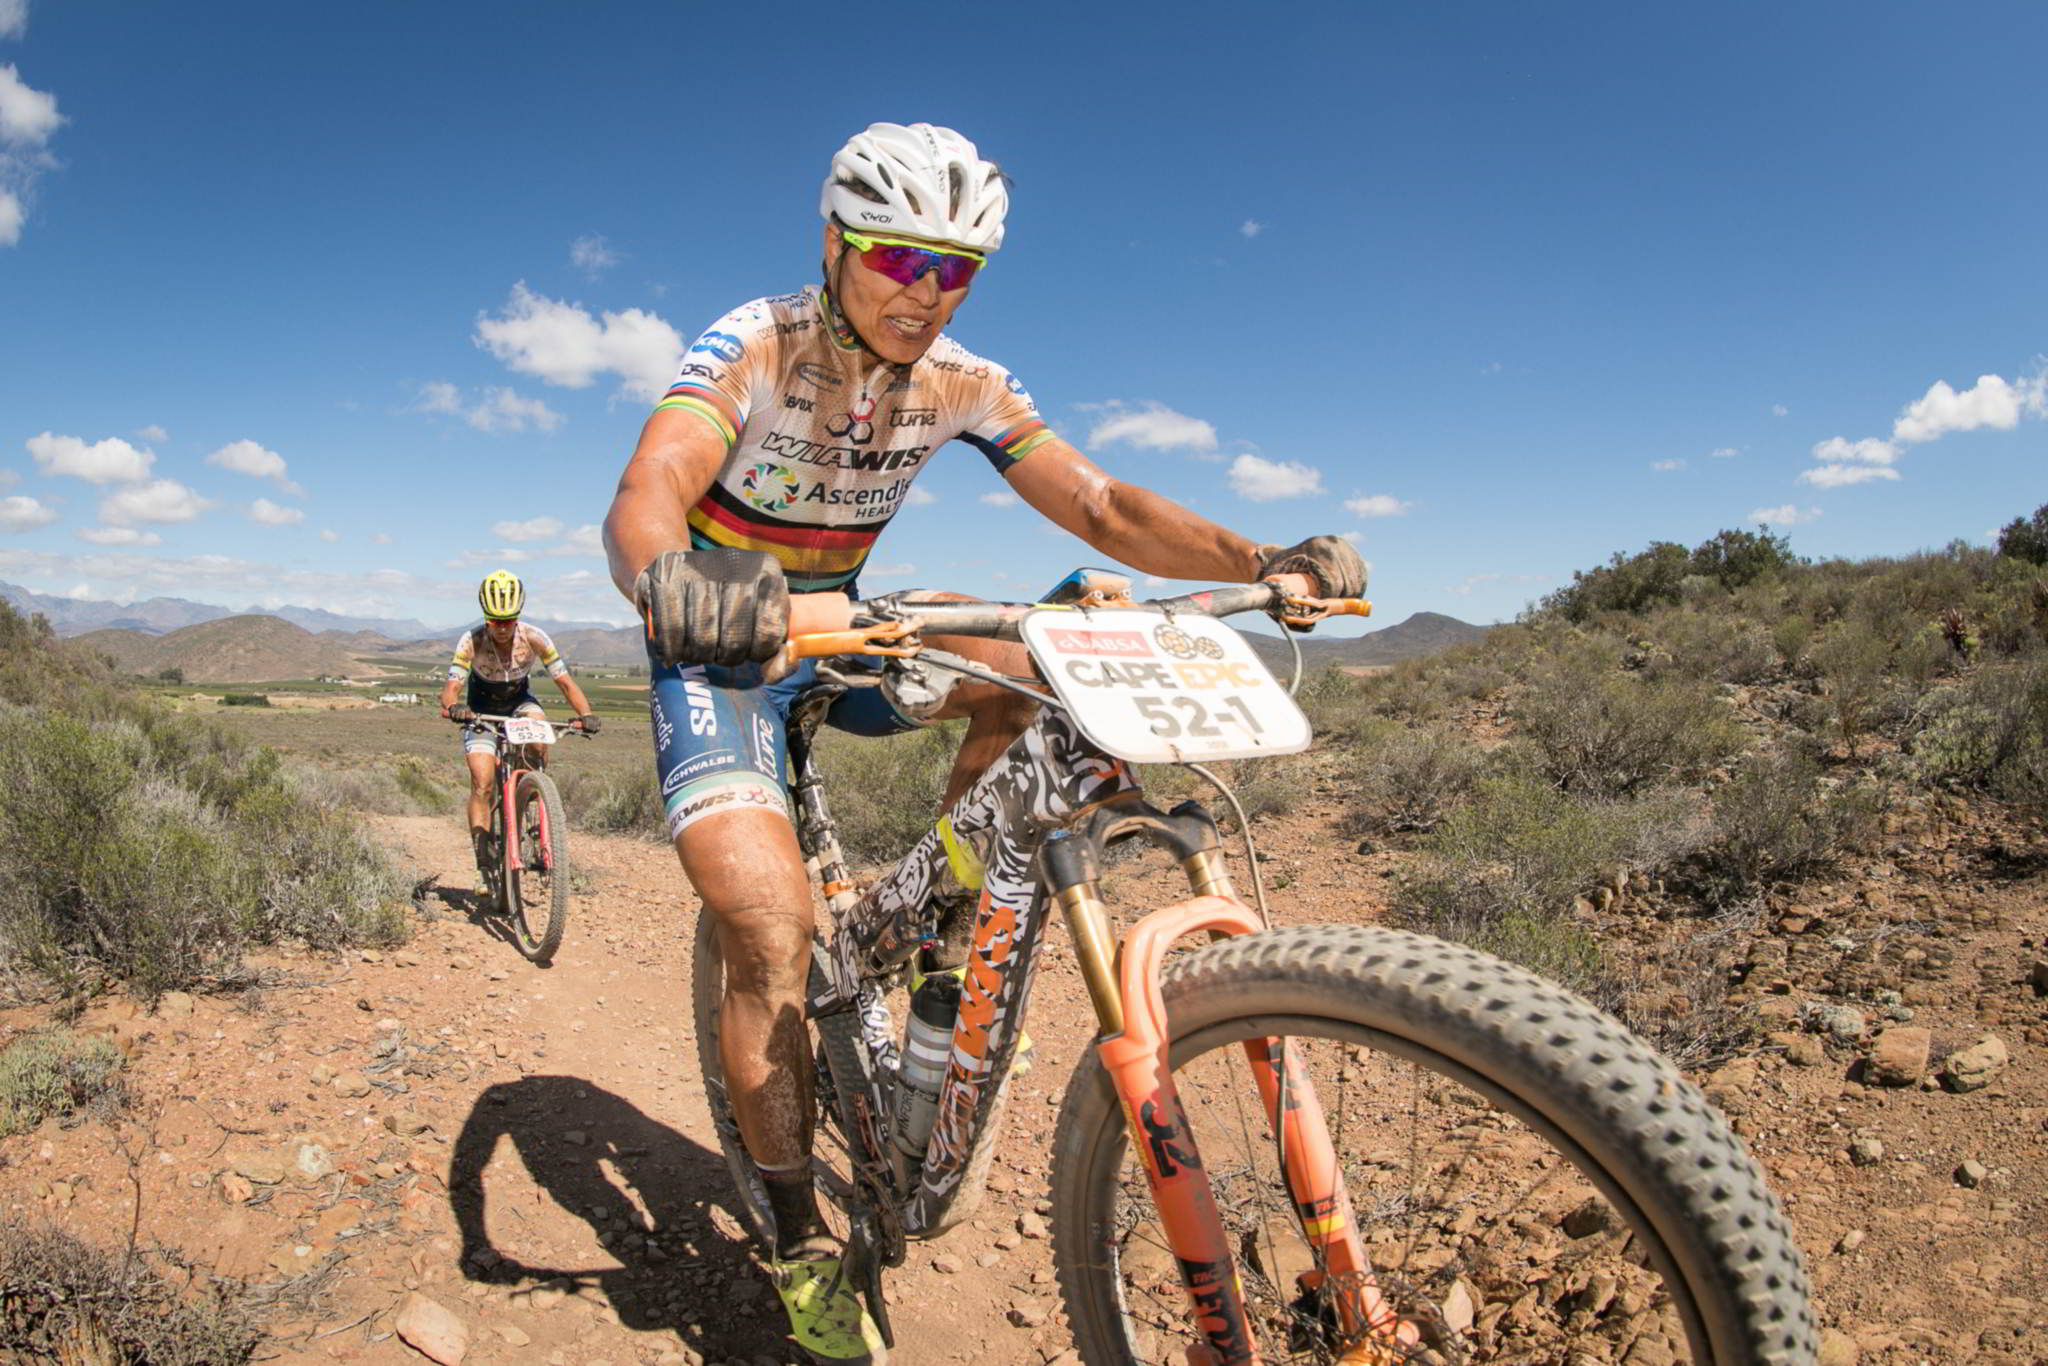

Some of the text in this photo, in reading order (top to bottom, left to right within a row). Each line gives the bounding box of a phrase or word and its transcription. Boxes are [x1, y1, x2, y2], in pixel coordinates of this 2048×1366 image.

[889, 406, 938, 428] tune
[761, 431, 931, 471] WIAWIS
[1091, 635, 1145, 652] ABSA
[1064, 660, 1262, 690] CAPE EPIC
[677, 662, 717, 737] WIS
[1131, 695, 1266, 739] 52-1
[667, 754, 736, 788] SCHWALBE
